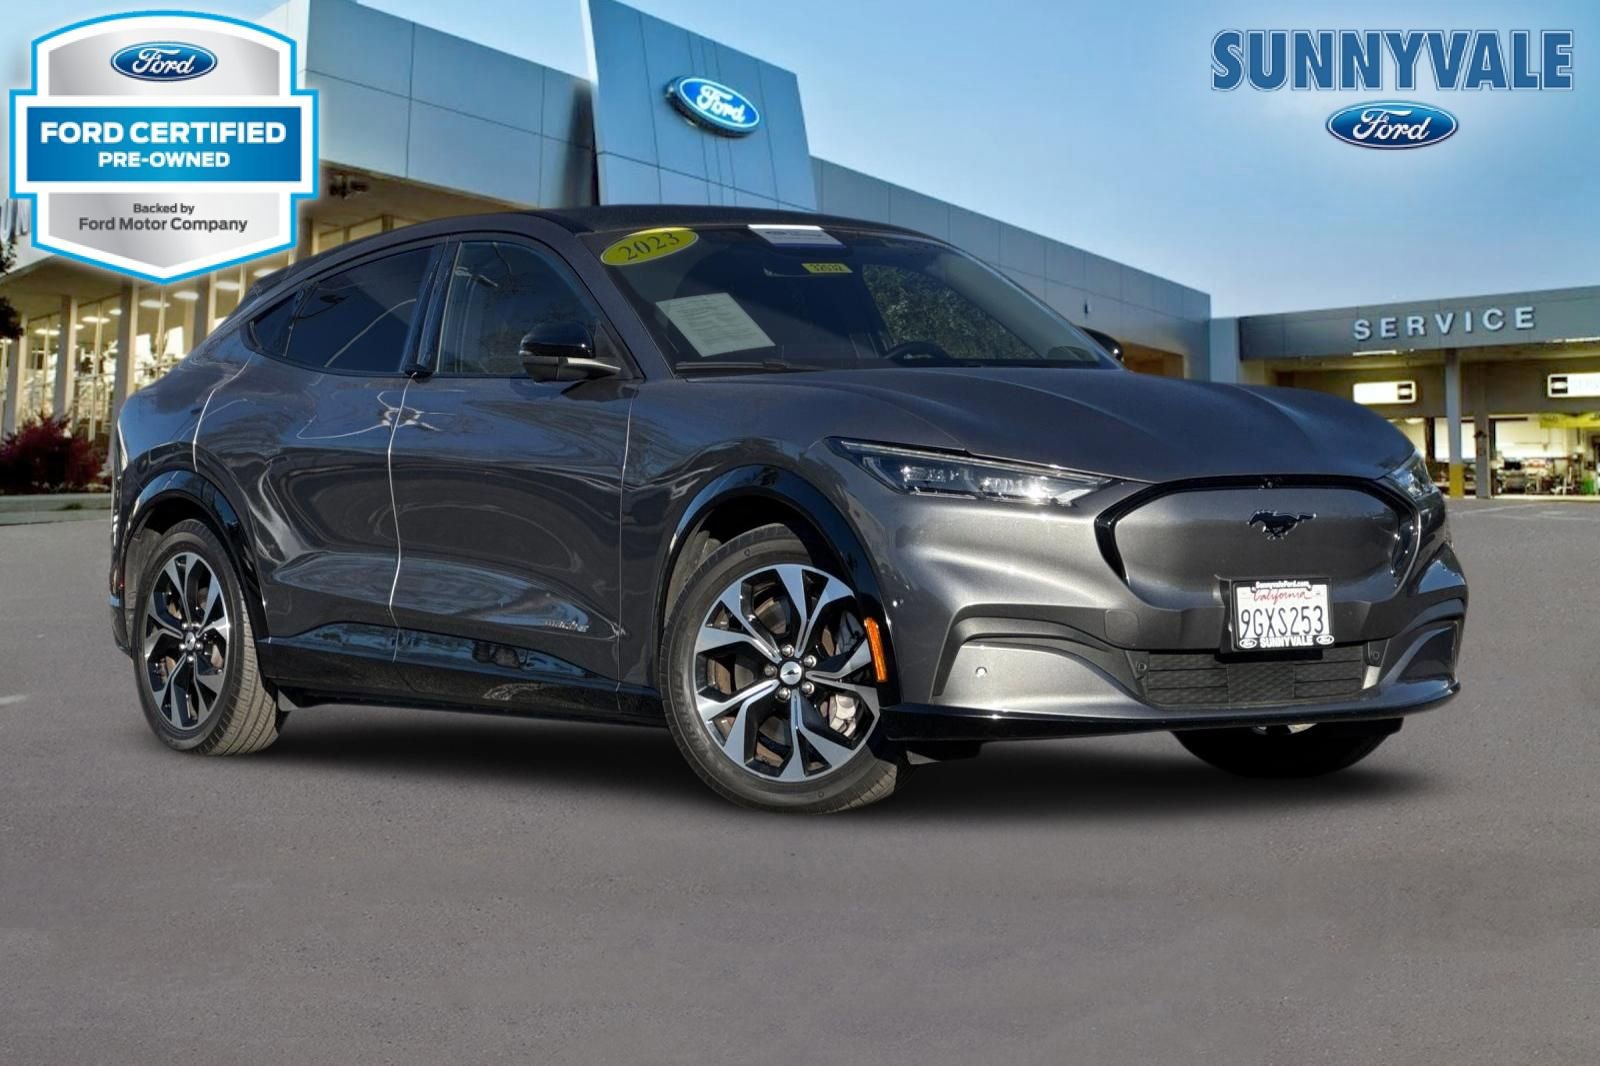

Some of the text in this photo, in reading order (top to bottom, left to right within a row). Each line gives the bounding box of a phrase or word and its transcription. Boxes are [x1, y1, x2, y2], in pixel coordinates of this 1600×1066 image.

[696, 84, 745, 122] Ford
[622, 230, 682, 260] 2023
[1354, 306, 1536, 340] SERVICE
[1253, 589, 1311, 605] California
[1241, 605, 1324, 638] 9GXS253
[1259, 635, 1314, 648] SUNNYVALE
